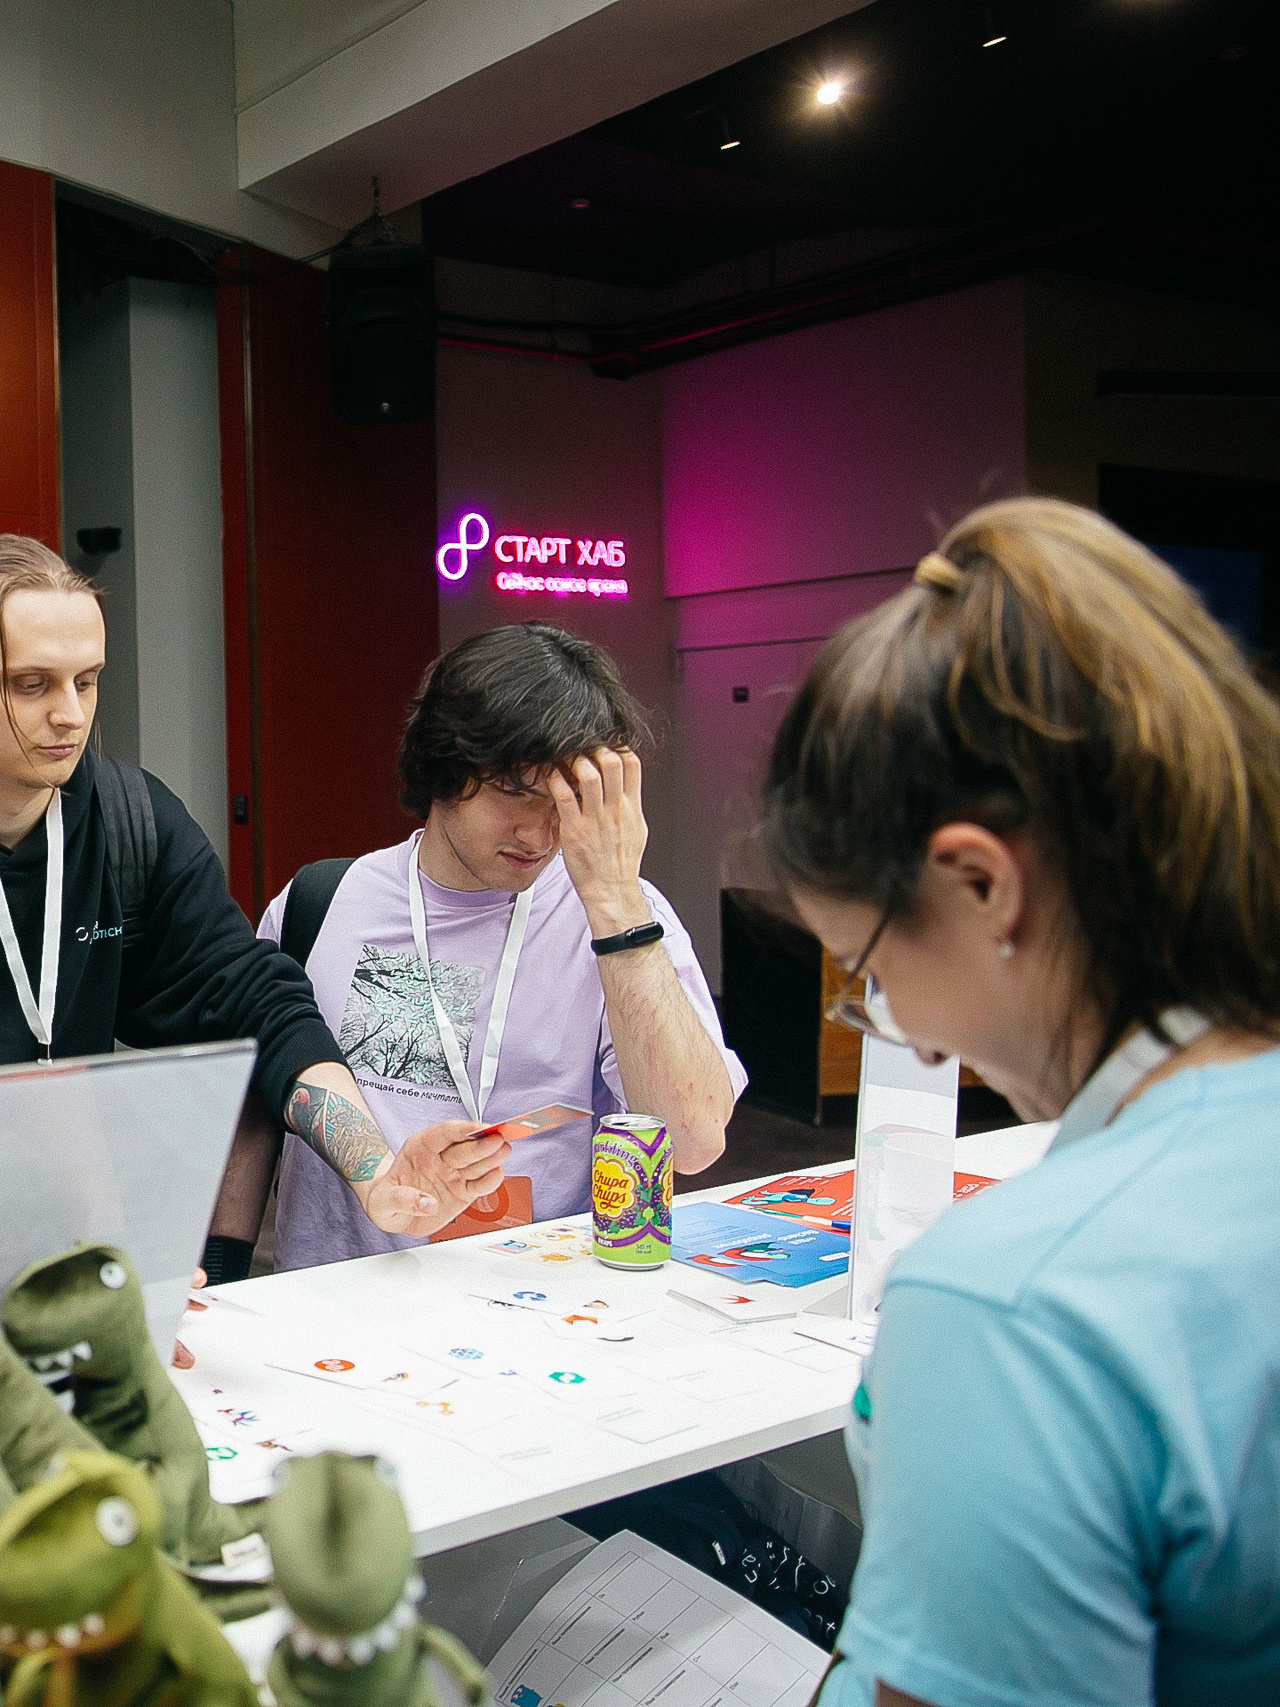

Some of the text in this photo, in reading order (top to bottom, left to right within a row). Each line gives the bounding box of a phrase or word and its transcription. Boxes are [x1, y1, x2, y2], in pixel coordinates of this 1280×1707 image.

[494, 535, 626, 567] СТАРТ ХАБ
[395, 1087, 420, 1099] себе
[594, 1169, 629, 1190] Chupa
[594, 1184, 627, 1209] Chups
